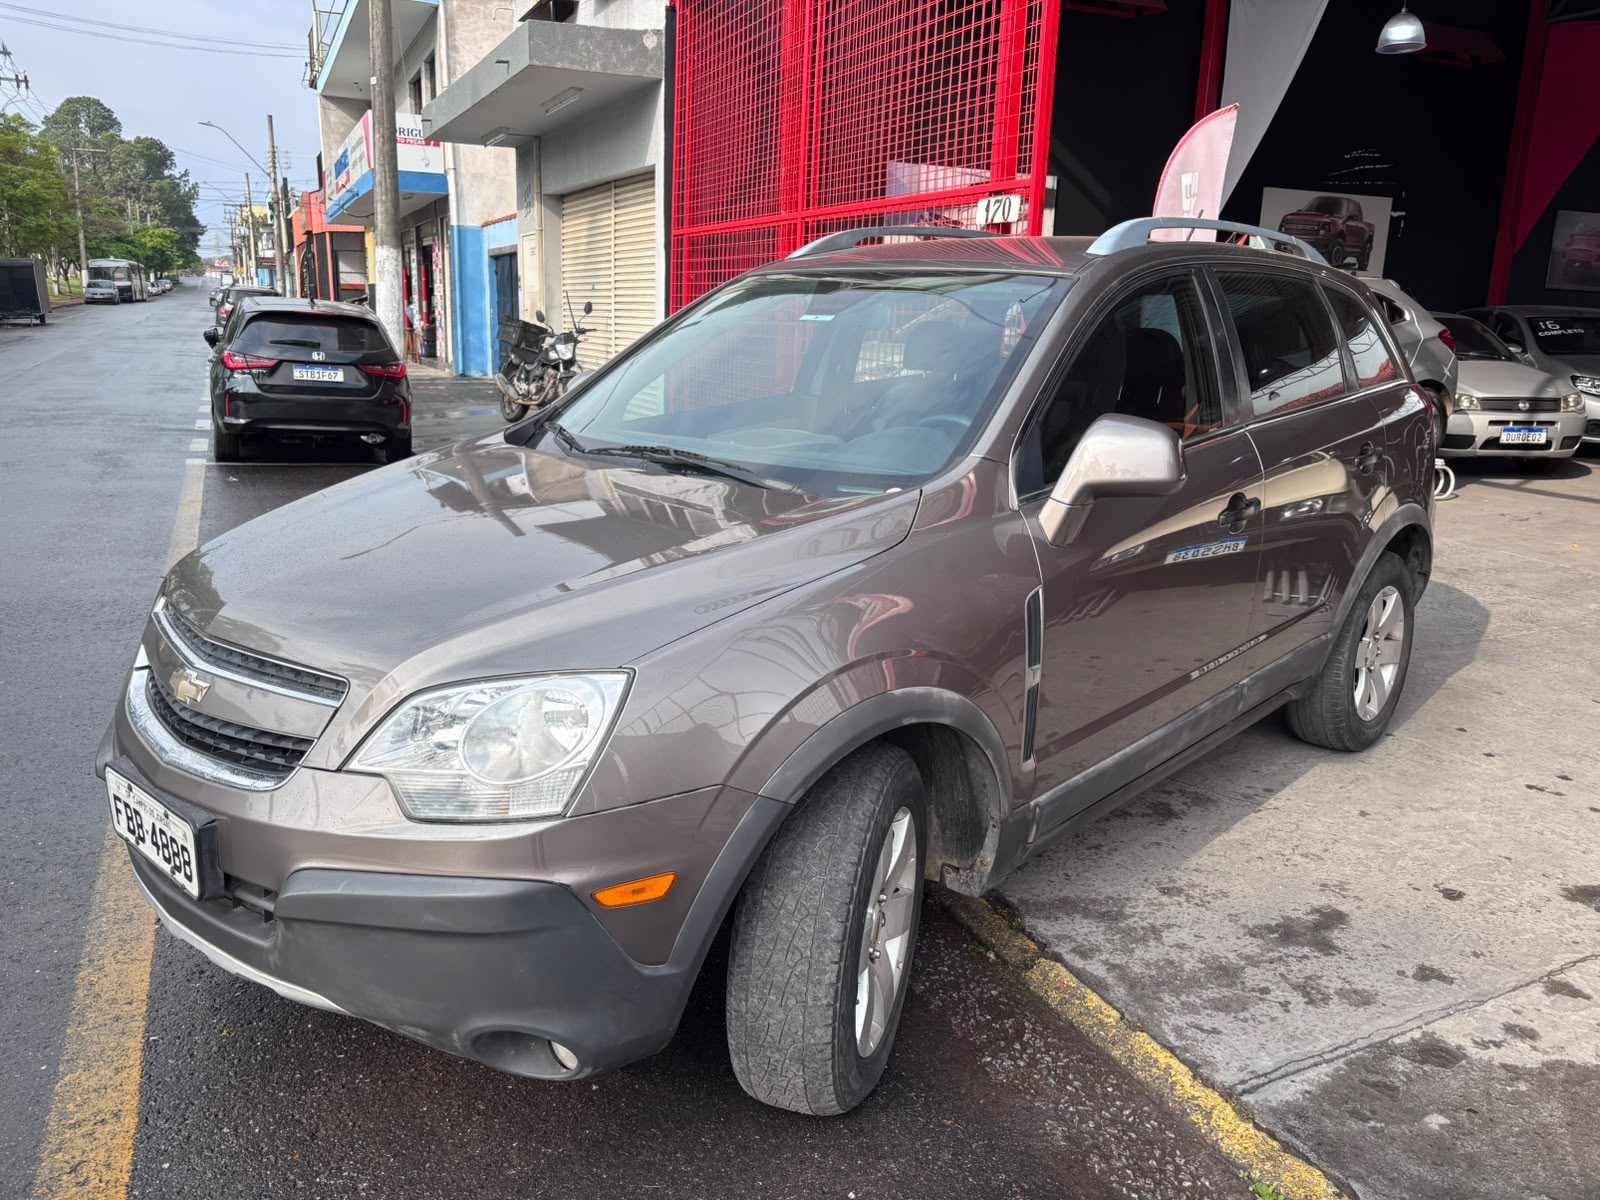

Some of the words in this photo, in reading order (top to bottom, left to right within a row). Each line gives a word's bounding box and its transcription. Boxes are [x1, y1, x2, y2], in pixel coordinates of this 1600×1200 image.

[985, 197, 1012, 223] 170
[1538, 328, 1584, 337] COMPLETO
[298, 369, 338, 380] STB1F67
